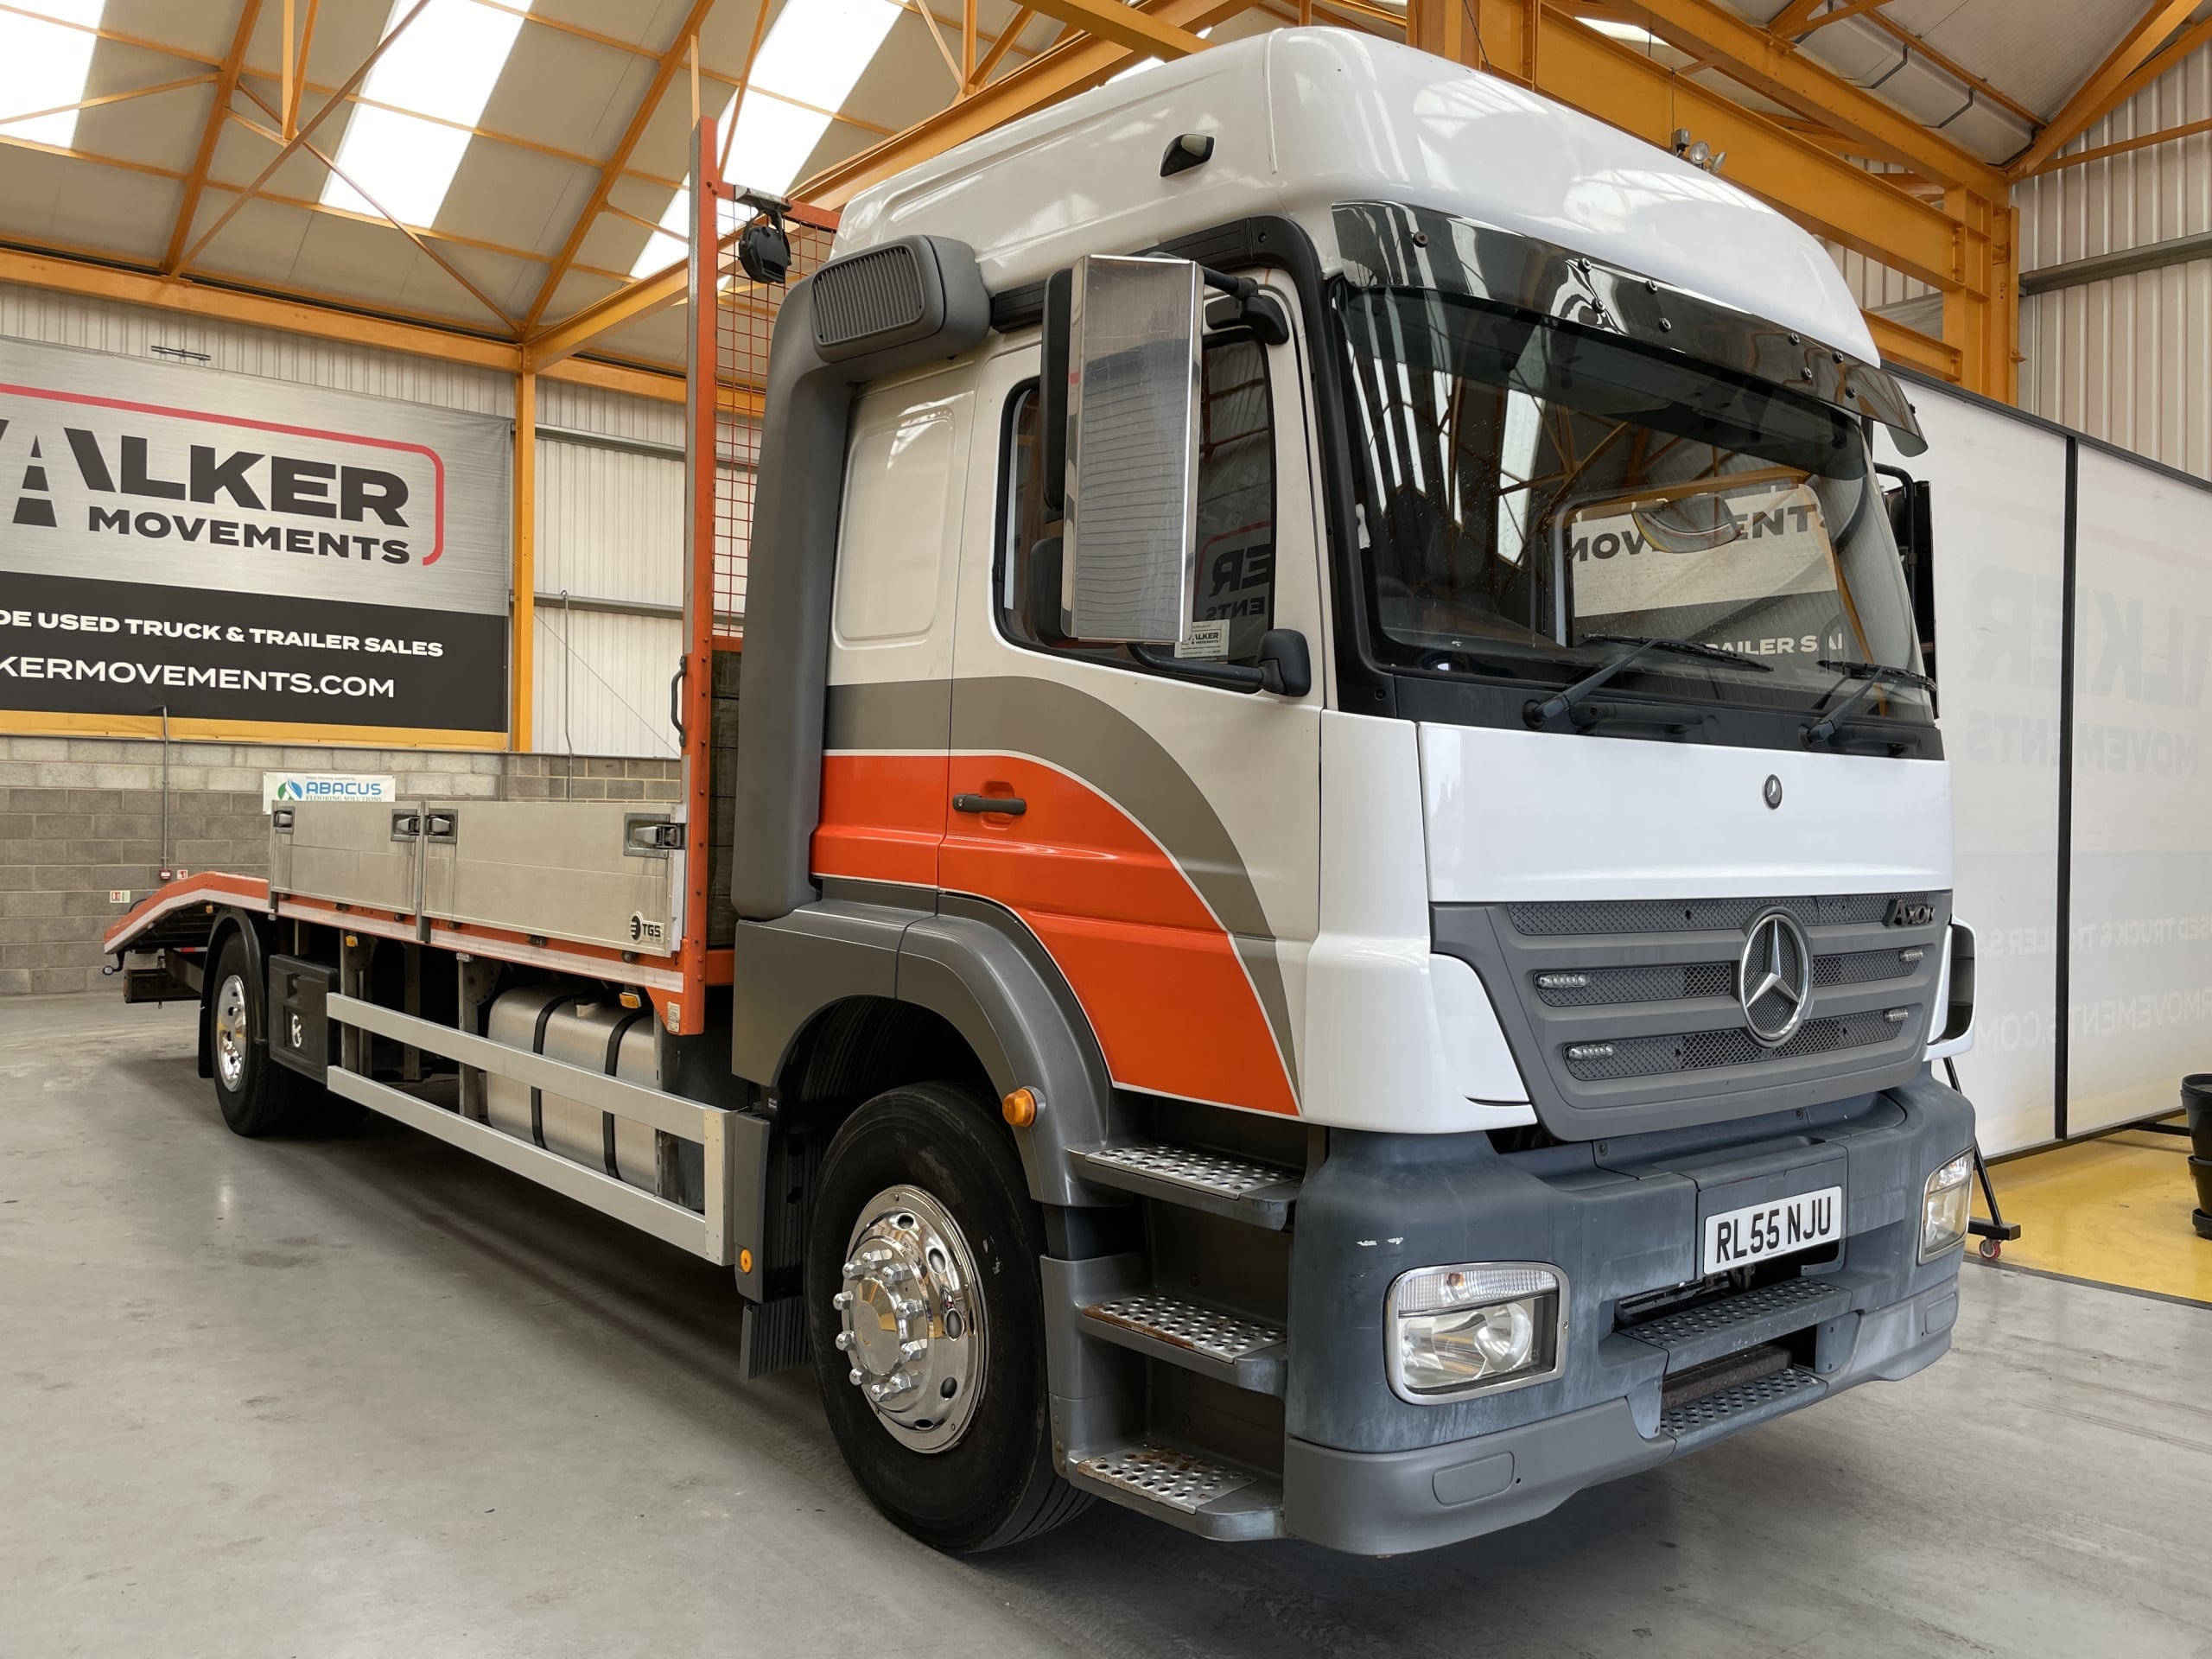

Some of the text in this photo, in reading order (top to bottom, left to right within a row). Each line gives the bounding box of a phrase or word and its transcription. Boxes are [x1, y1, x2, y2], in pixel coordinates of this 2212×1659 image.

[0, 419, 410, 528] ALKER
[88, 505, 410, 565] MOVEMENTS
[38, 612, 120, 632] USED
[124, 619, 221, 641] TRUCK
[226, 626, 245, 643] &
[249, 628, 359, 651] TRAILER
[365, 638, 443, 657] SALES
[0, 656, 395, 698] KERMOVEMENTS.COM
[306, 782, 382, 795] ABACUS
[642, 924, 661, 938] TGS
[1716, 1196, 1831, 1263] RL55 NJU
